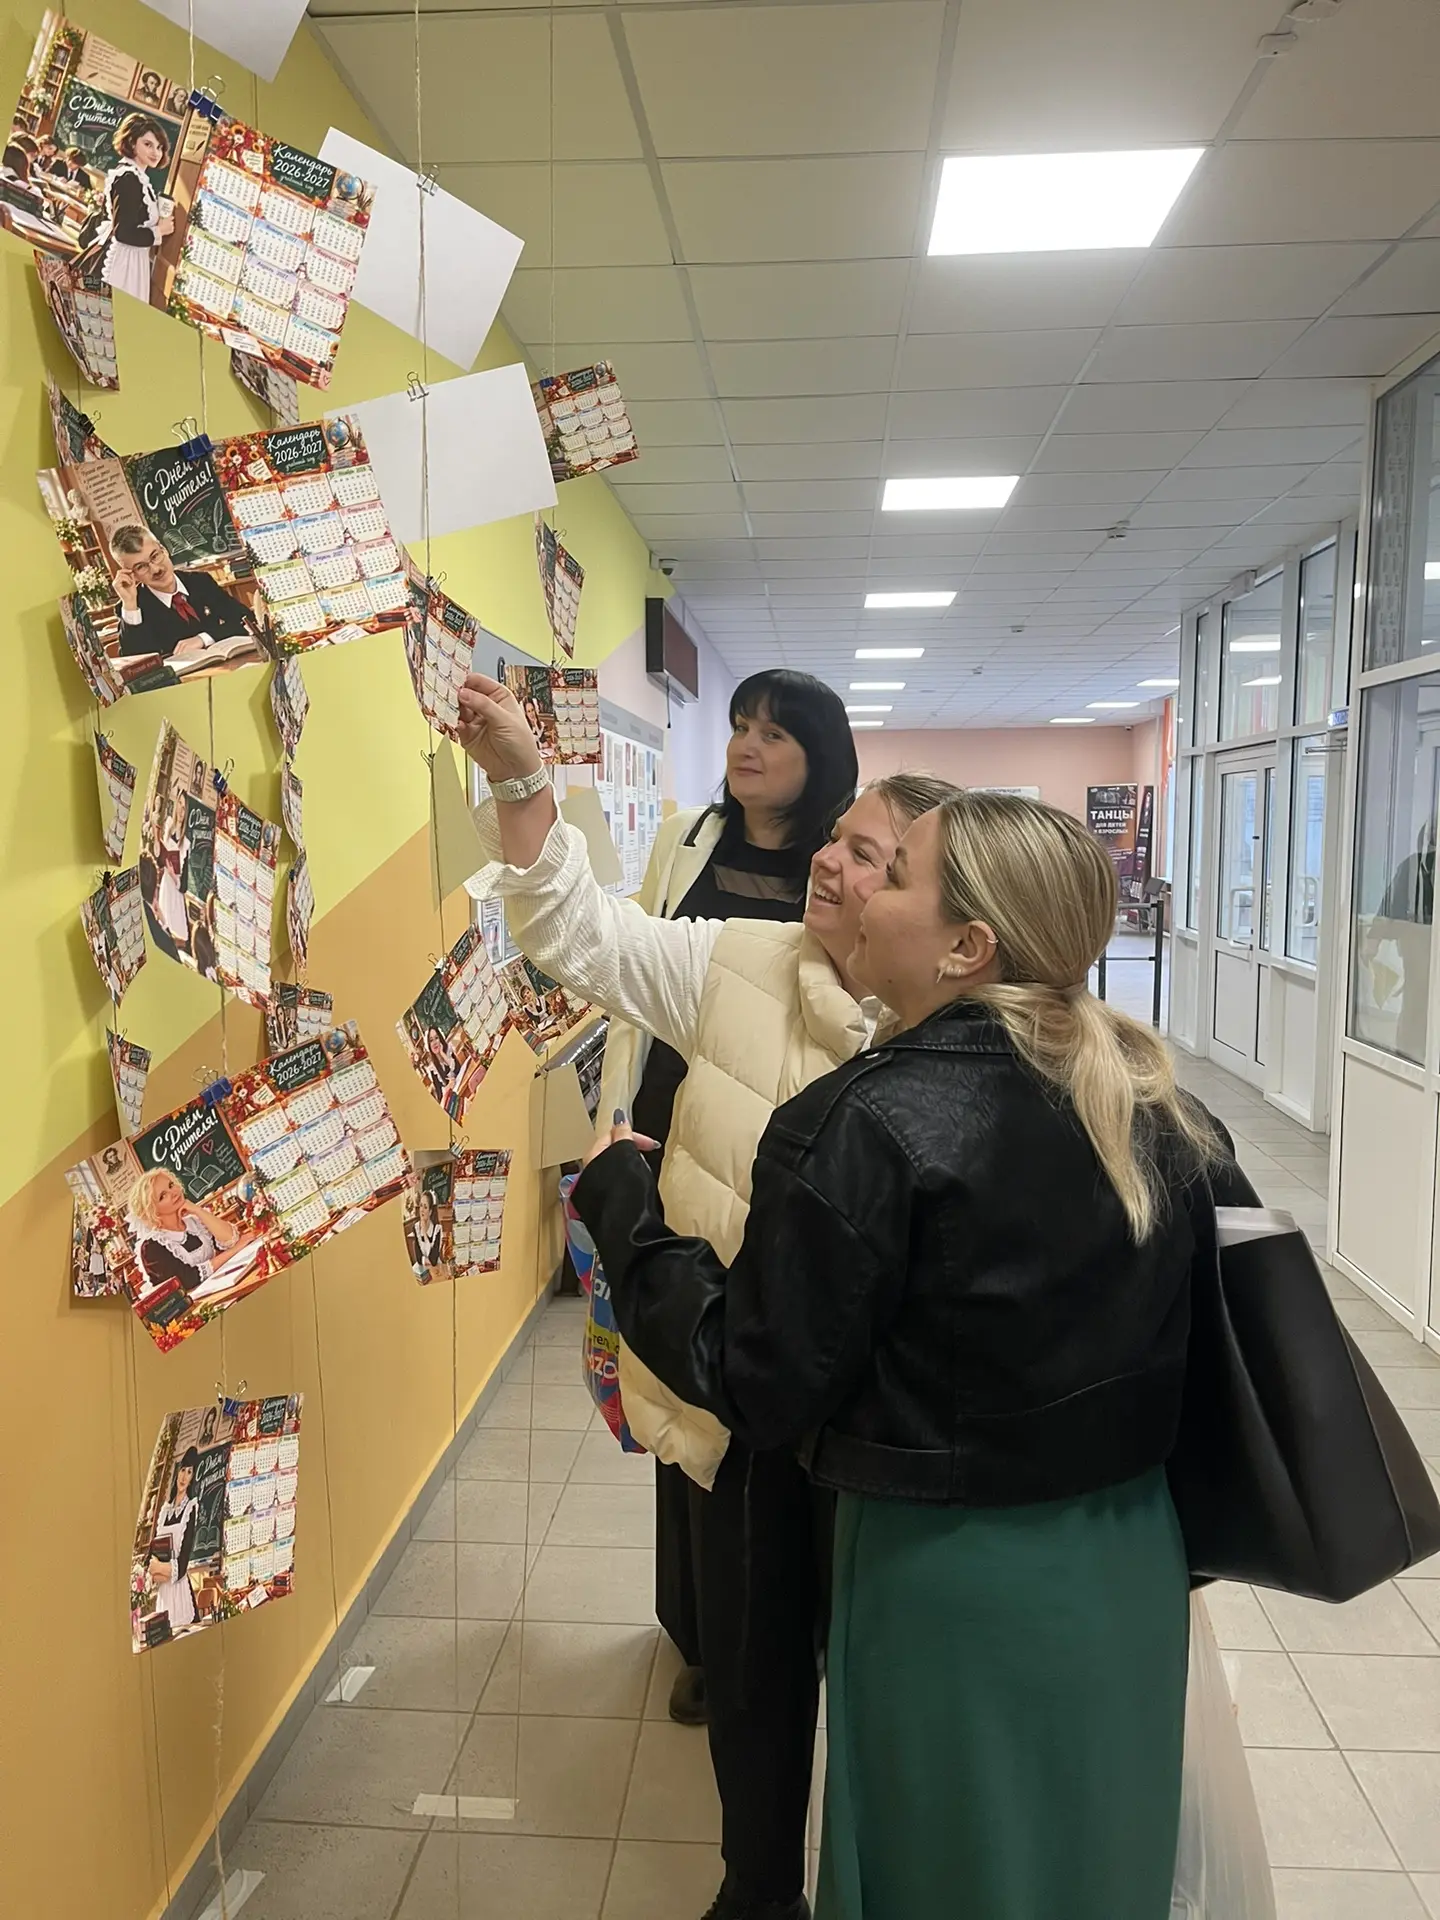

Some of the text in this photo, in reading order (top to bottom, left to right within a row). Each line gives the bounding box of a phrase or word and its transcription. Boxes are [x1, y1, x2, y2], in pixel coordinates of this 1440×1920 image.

[69, 95, 81, 111] С
[74, 111, 122, 129] учителя!
[273, 144, 333, 176] Календарь
[274, 159, 330, 188] 2026-2027
[266, 428, 321, 453] Календарь
[274, 440, 323, 465] 2026-2027
[144, 482, 159, 510] С
[154, 460, 193, 495] Днём
[163, 461, 214, 526] учителя!
[1090, 810, 1134, 821] ТАНЦЫ
[269, 1043, 320, 1076] Календарь
[276, 1051, 322, 1086] 2026-2027
[152, 1136, 168, 1163] С
[165, 1109, 204, 1150] Днём
[170, 1108, 218, 1171] учителя!
[195, 1459, 205, 1482] С
